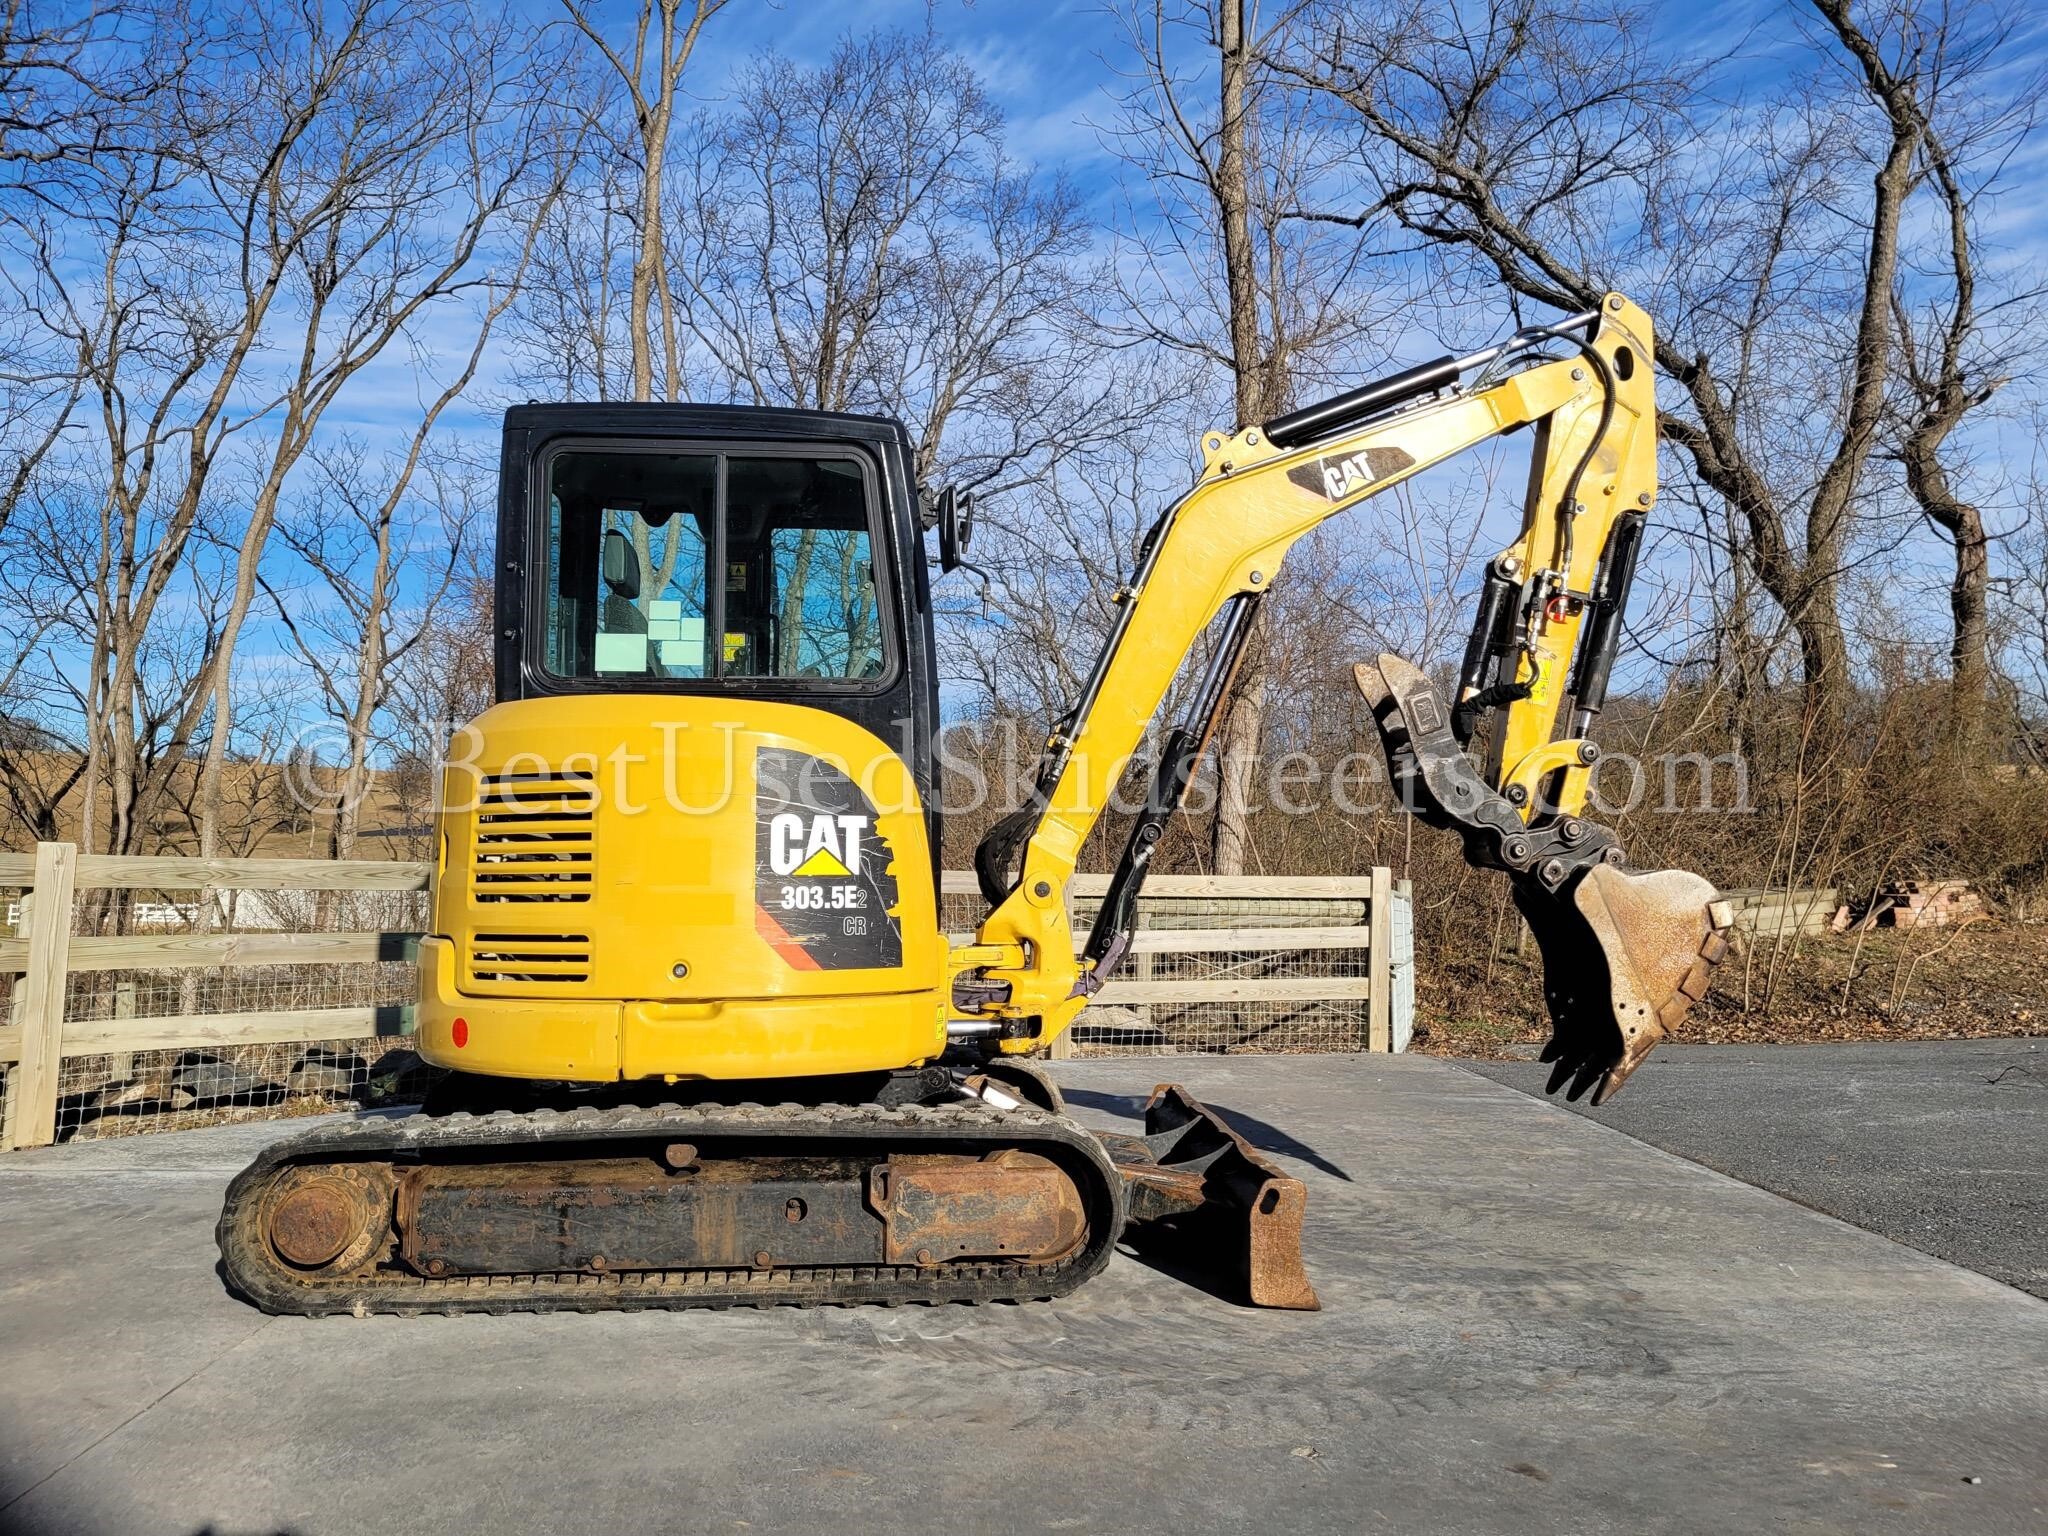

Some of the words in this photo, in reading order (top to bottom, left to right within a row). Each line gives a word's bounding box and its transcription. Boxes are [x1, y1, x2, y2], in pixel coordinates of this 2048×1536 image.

[1323, 451, 1375, 498] CAT
[770, 813, 868, 876] CAT
[842, 916, 868, 936] CR
